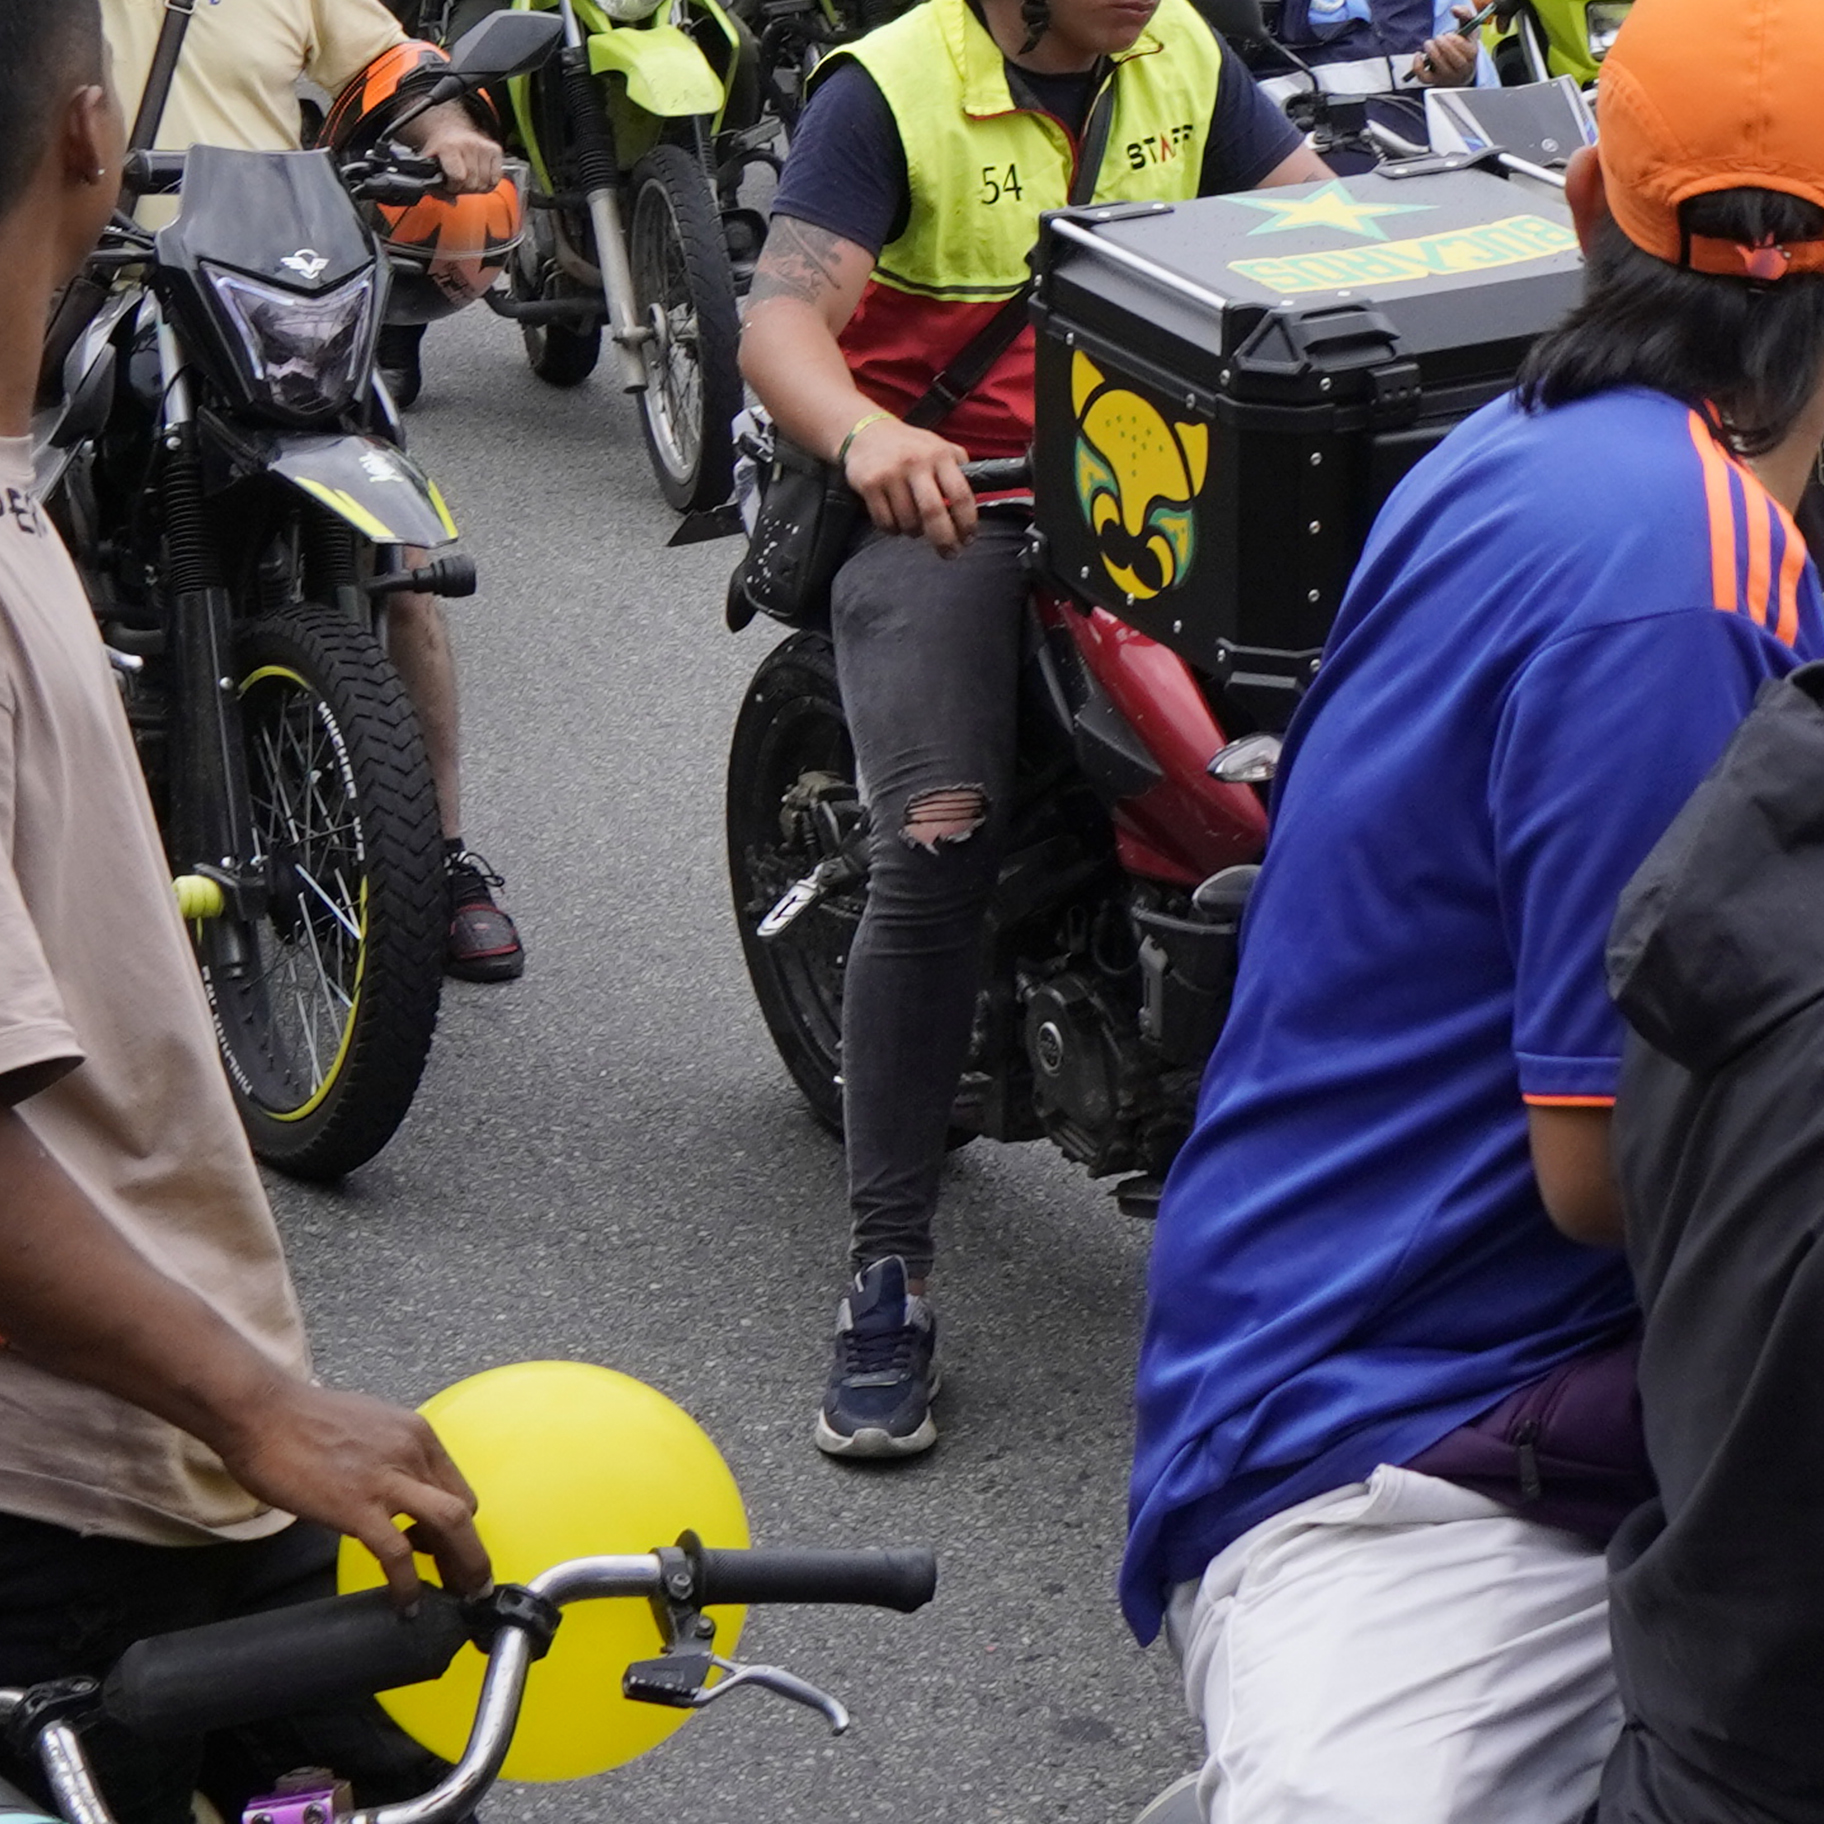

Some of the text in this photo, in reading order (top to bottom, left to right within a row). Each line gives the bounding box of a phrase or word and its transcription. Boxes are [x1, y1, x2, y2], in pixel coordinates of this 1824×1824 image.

[1125, 123, 1195, 171] STAFF
[978, 163, 1024, 206] 54
[1232, 215, 1578, 290] BUCAROS
